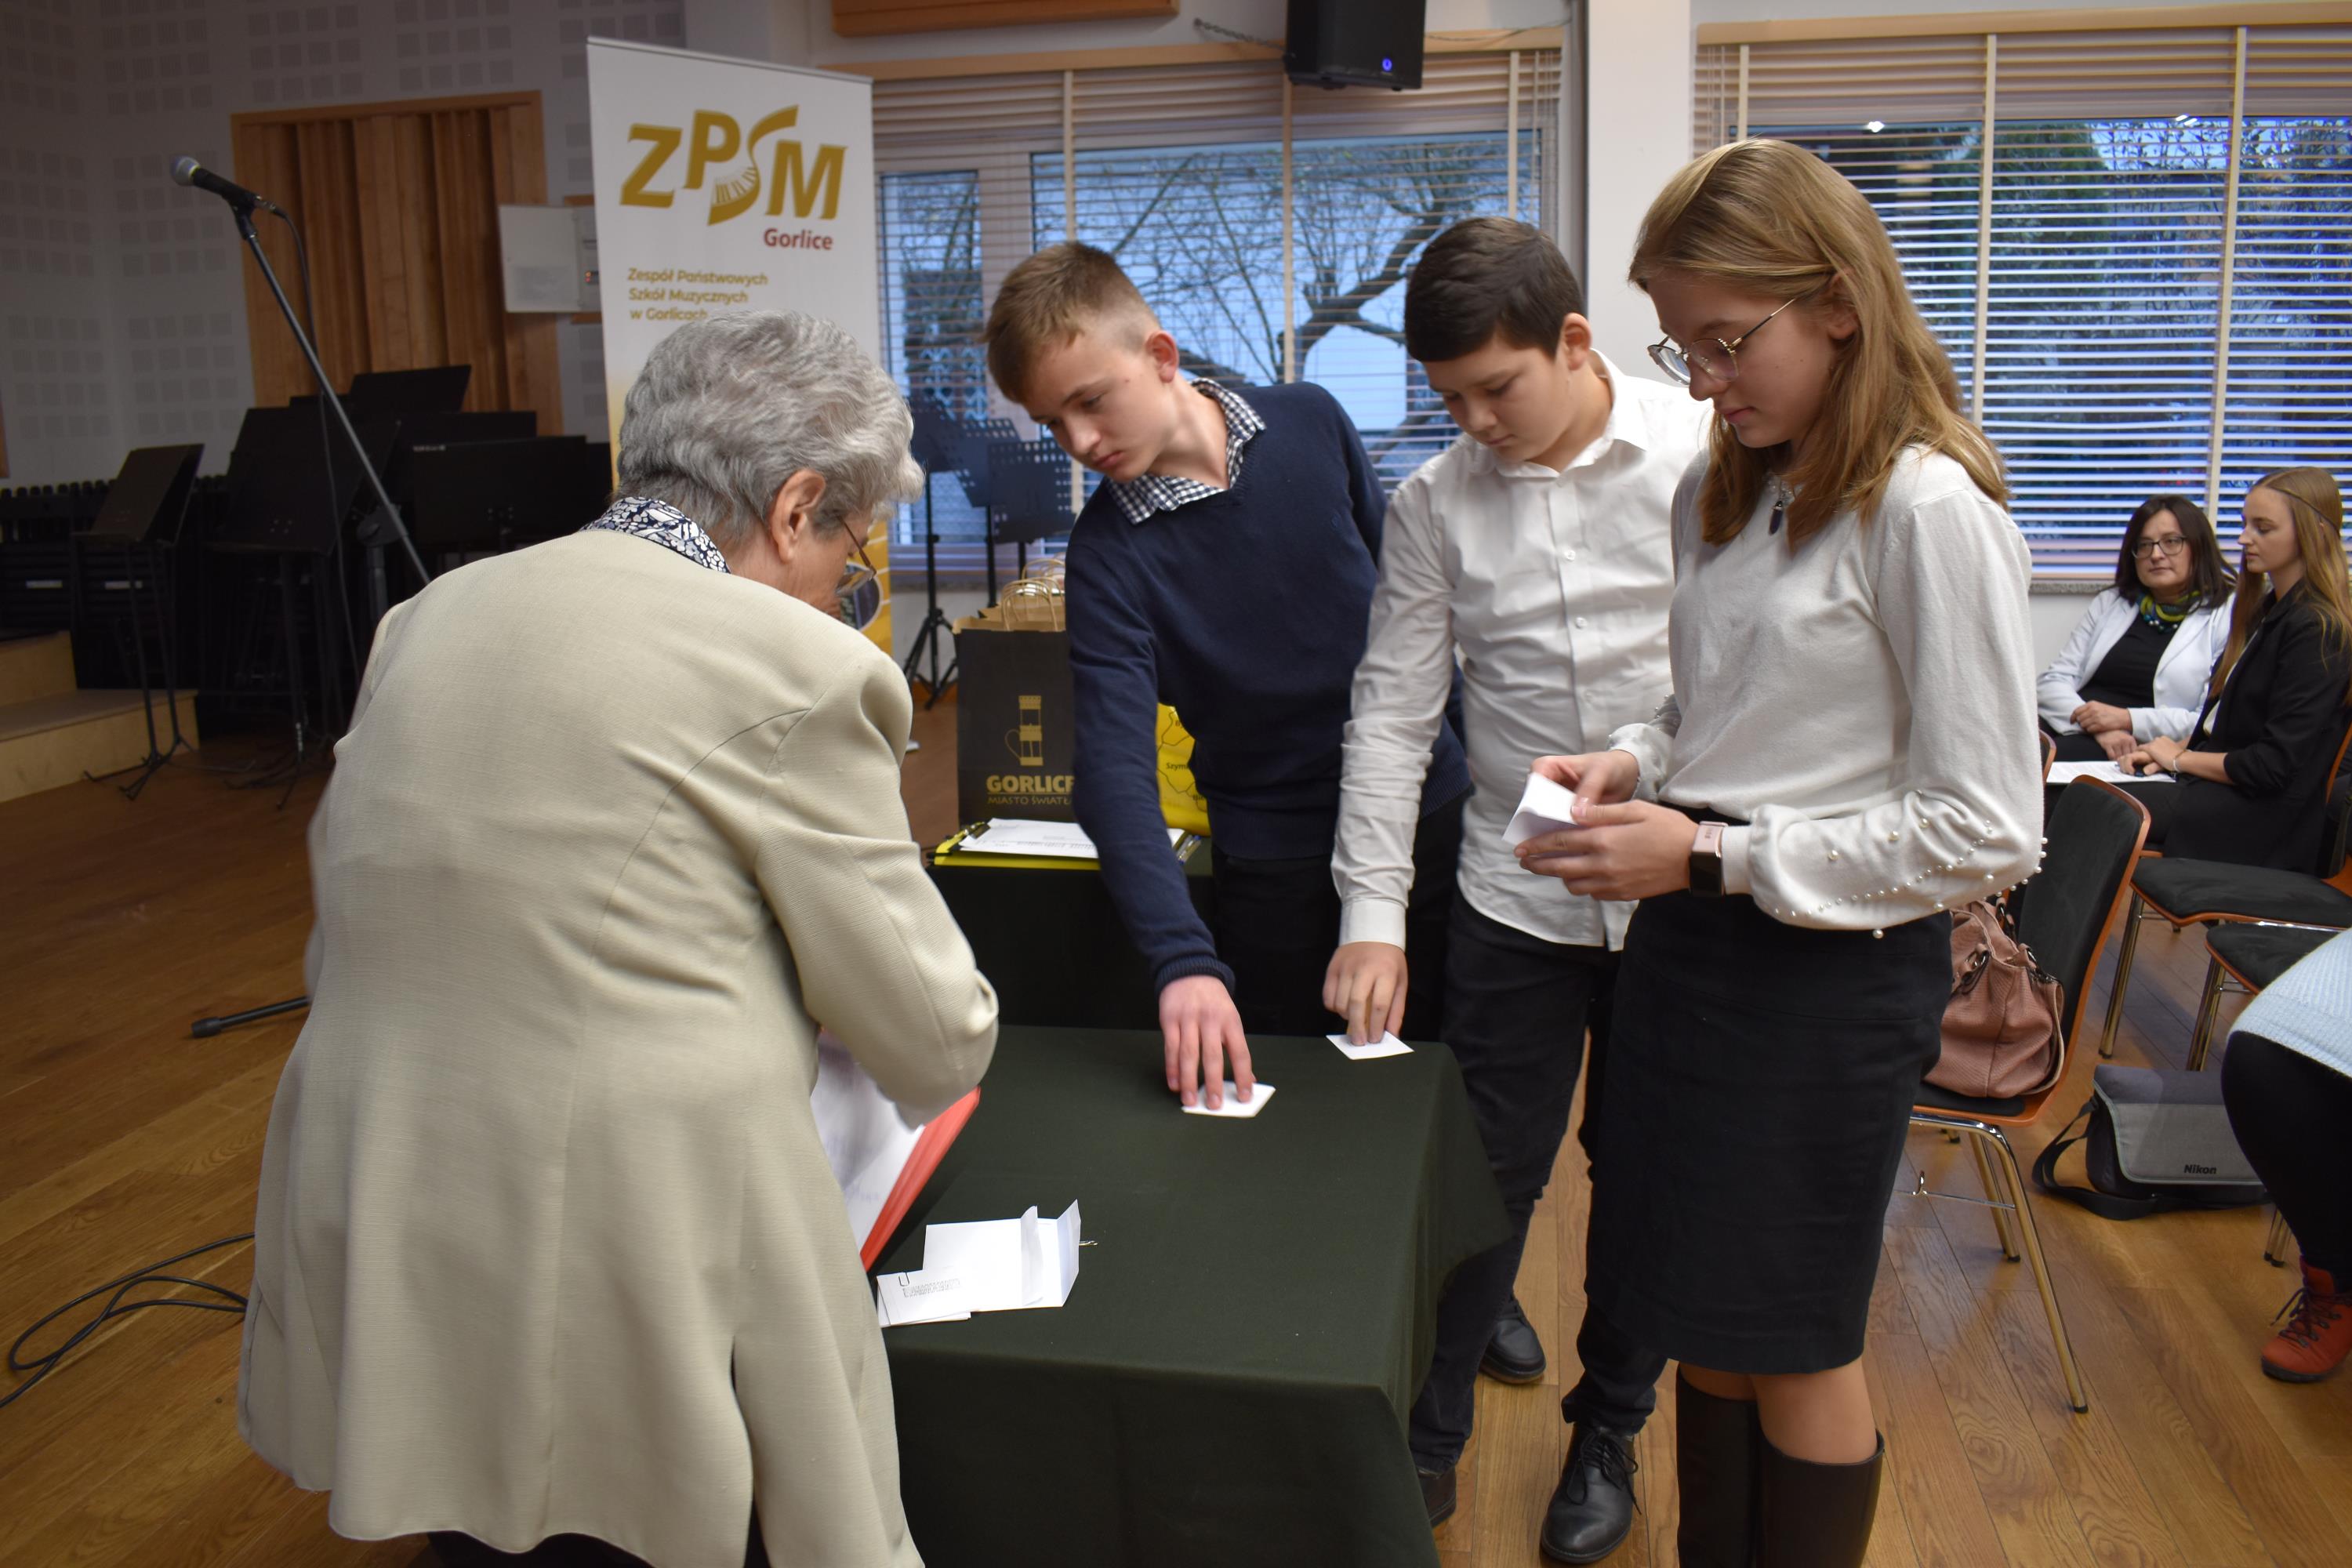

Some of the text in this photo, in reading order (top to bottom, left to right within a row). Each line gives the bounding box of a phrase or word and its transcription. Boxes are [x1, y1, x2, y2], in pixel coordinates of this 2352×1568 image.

[619, 104, 848, 226] ZPSM
[764, 228, 833, 249] Gorlice
[628, 267, 768, 288] Zespół Państwowych
[629, 288, 749, 305] Szkół Muzycznych
[630, 310, 642, 320] w
[988, 795, 1071, 805] MIASTO ŚWIATŁ
[2183, 1164, 2217, 1174] Nikon
